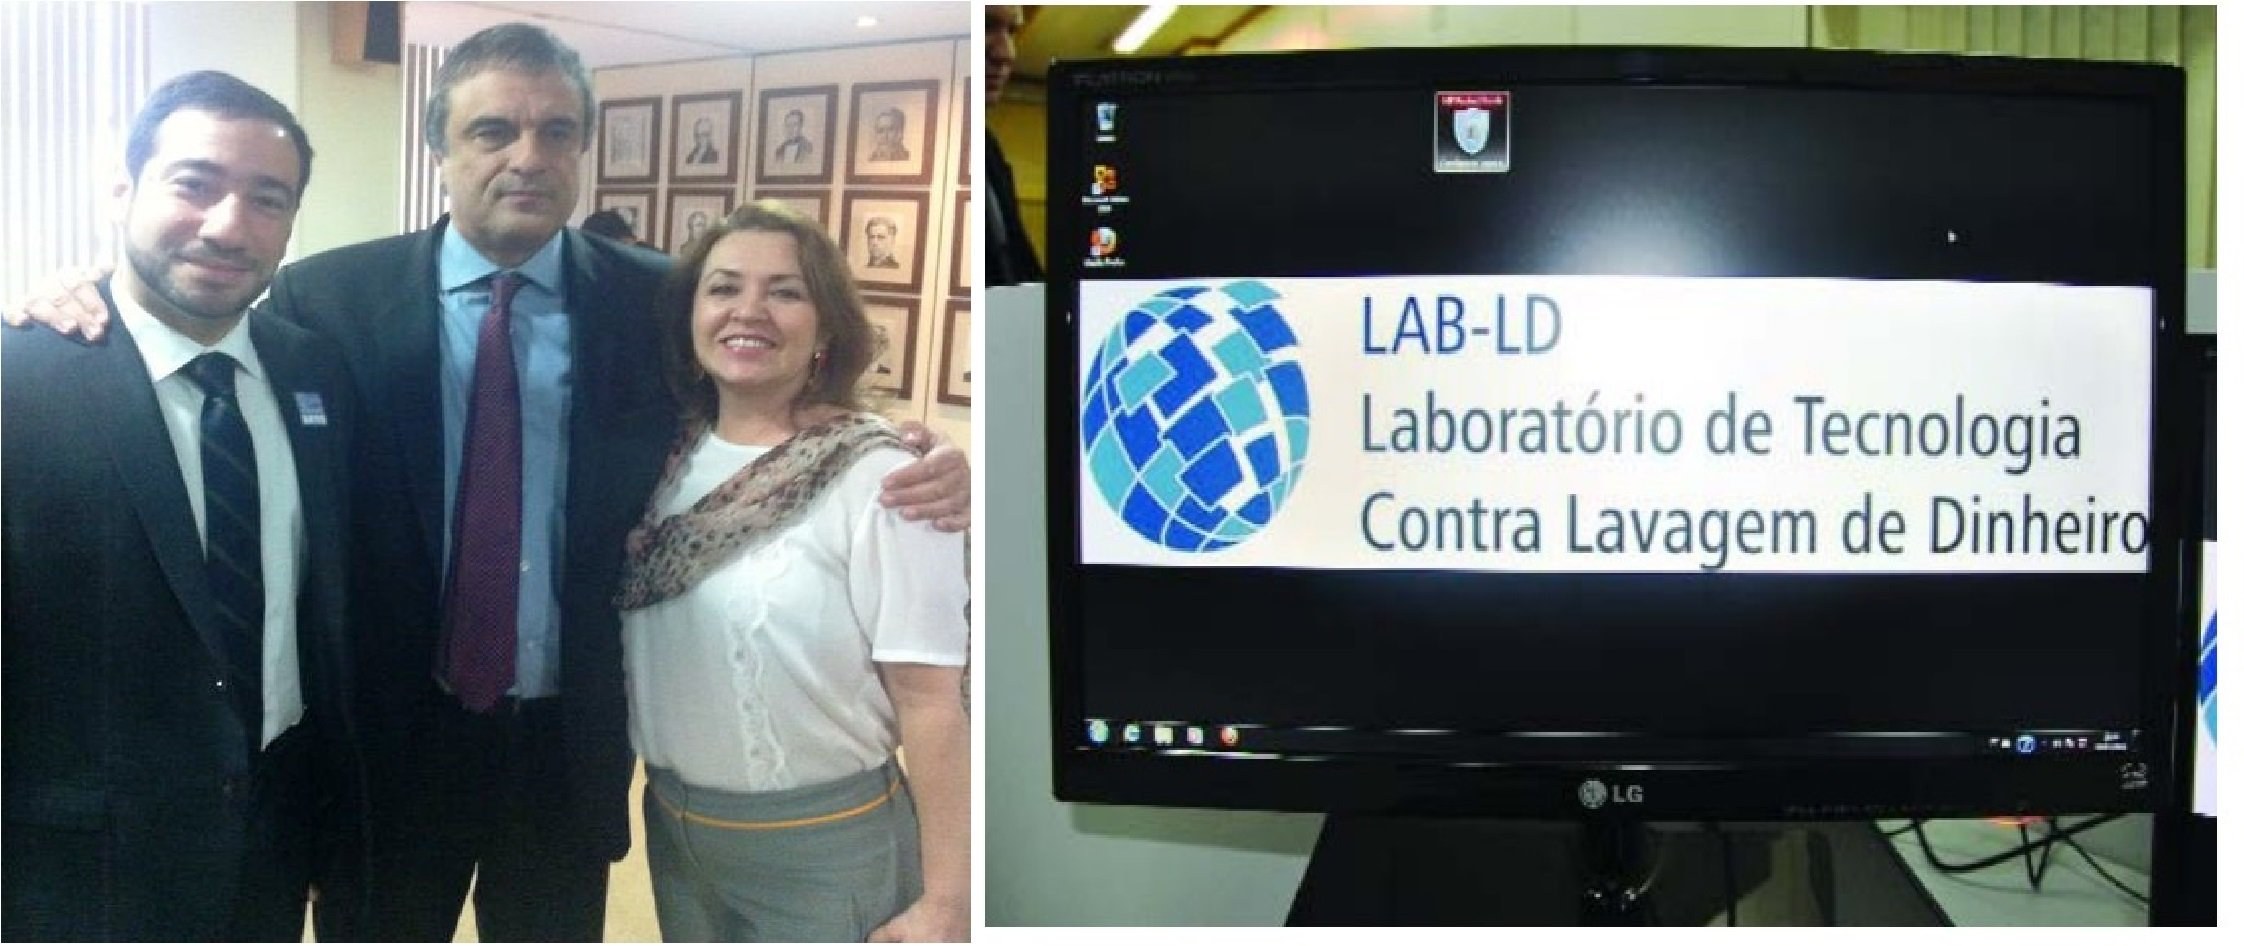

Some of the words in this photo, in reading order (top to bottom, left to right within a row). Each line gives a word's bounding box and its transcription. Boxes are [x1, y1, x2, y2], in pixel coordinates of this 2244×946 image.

[1362, 294, 1563, 356] LAB-LD
[1362, 391, 1684, 455] Laboratório
[1705, 392, 1773, 456] de
[1795, 394, 2082, 475] Tecnologia
[1361, 491, 1542, 553] Contra
[1568, 494, 1817, 570] Lavagem
[1842, 493, 1907, 555] de
[1930, 493, 2149, 555] Dinheiro
[1613, 784, 1643, 803] LG
